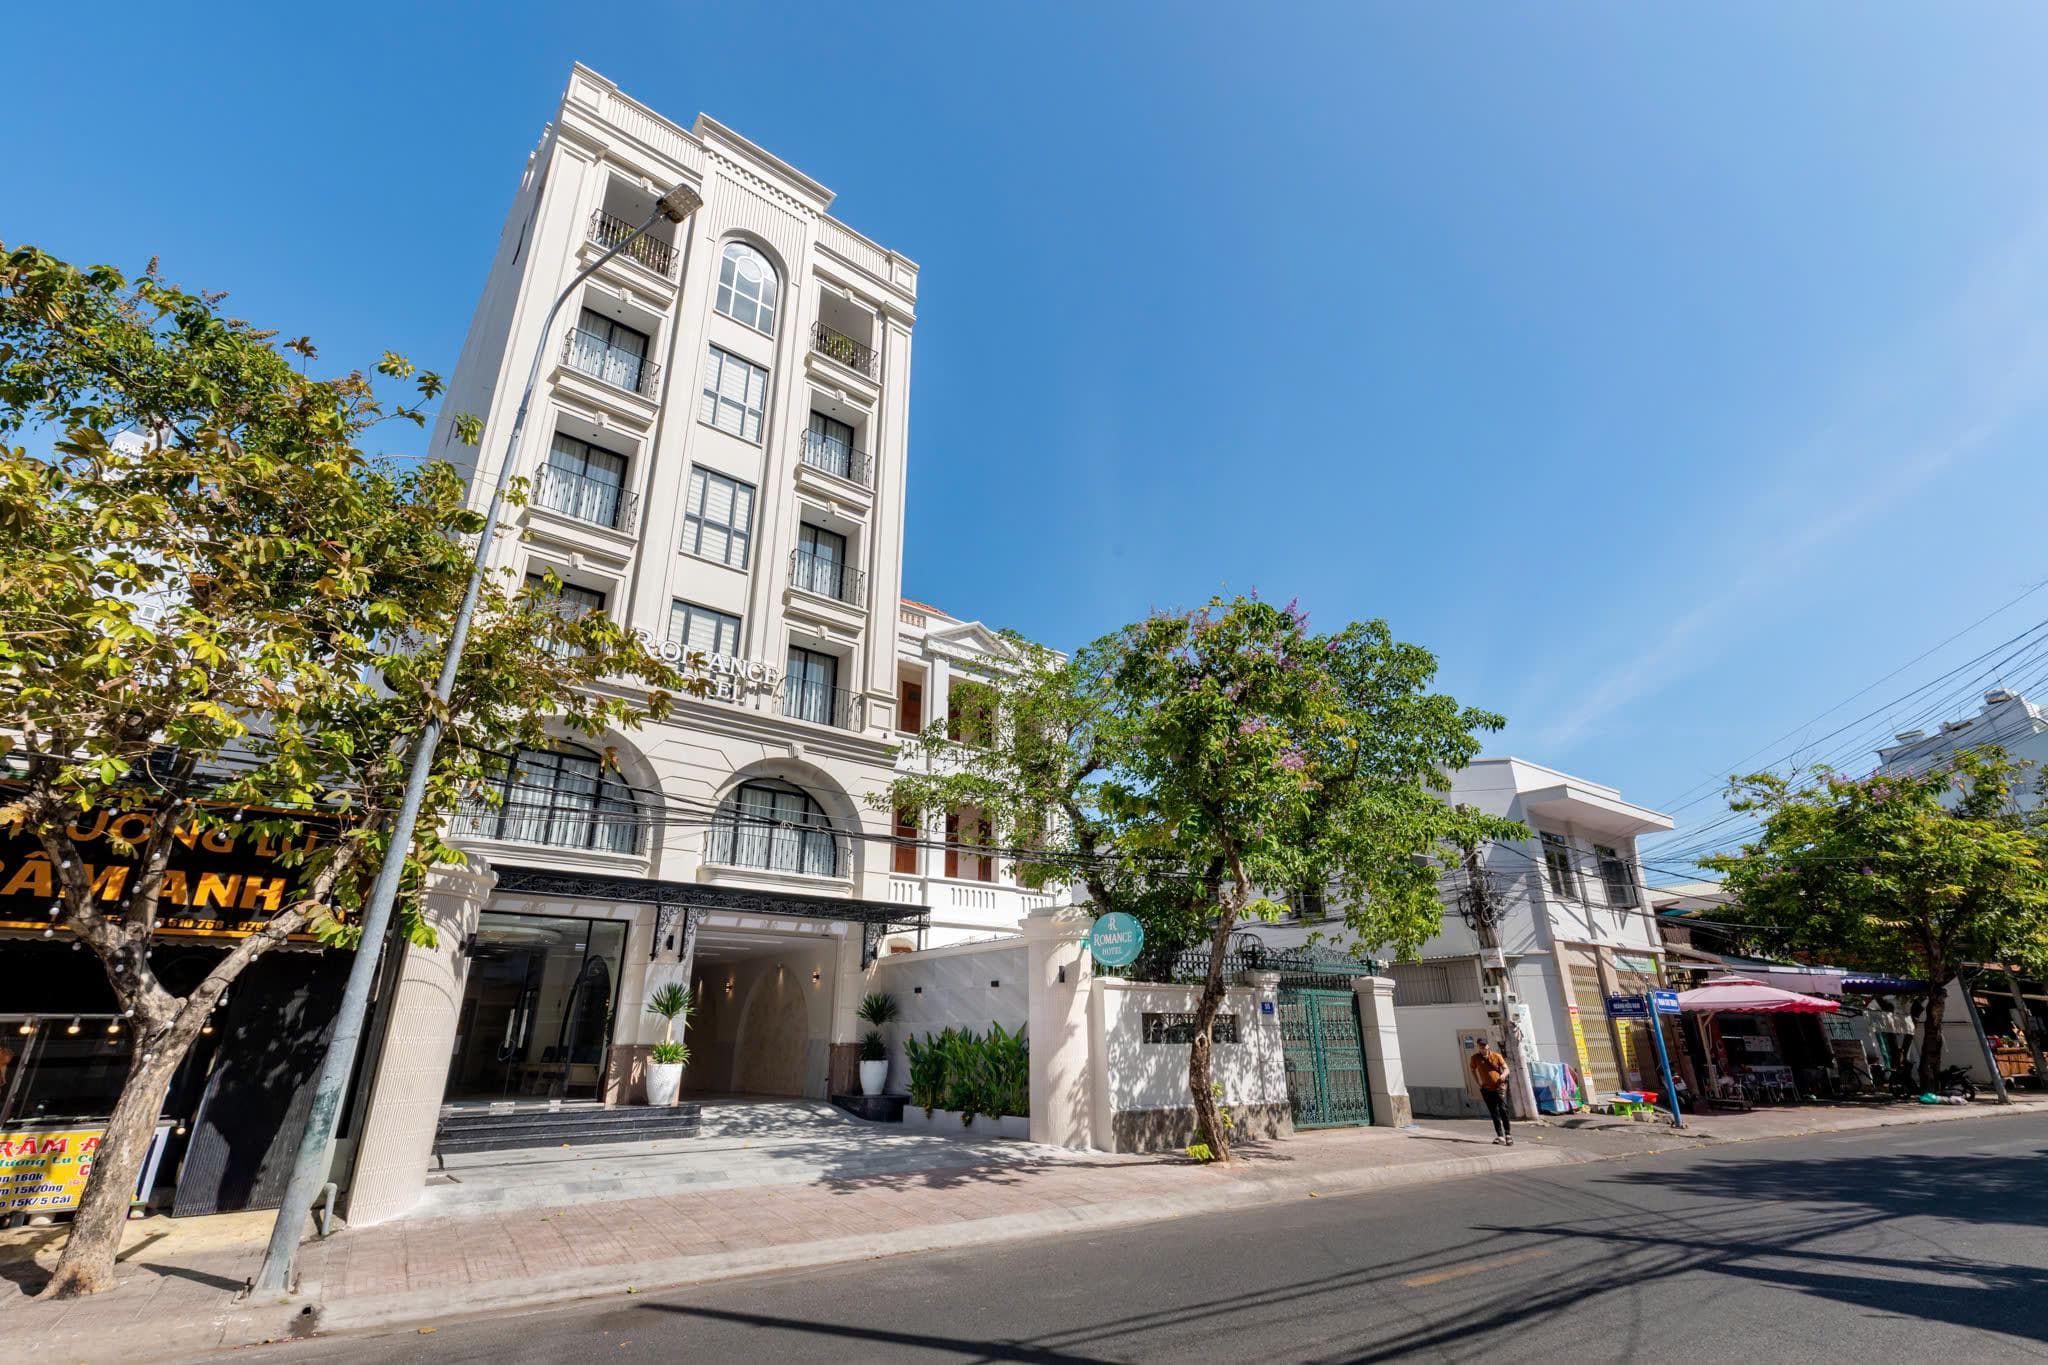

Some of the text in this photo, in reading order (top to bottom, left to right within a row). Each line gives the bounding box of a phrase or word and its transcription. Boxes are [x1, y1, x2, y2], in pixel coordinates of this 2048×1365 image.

[0, 851, 287, 911] ÂM ANH
[1093, 931, 1133, 947] ROMANCE
[1102, 946, 1123, 956] HOTEL
